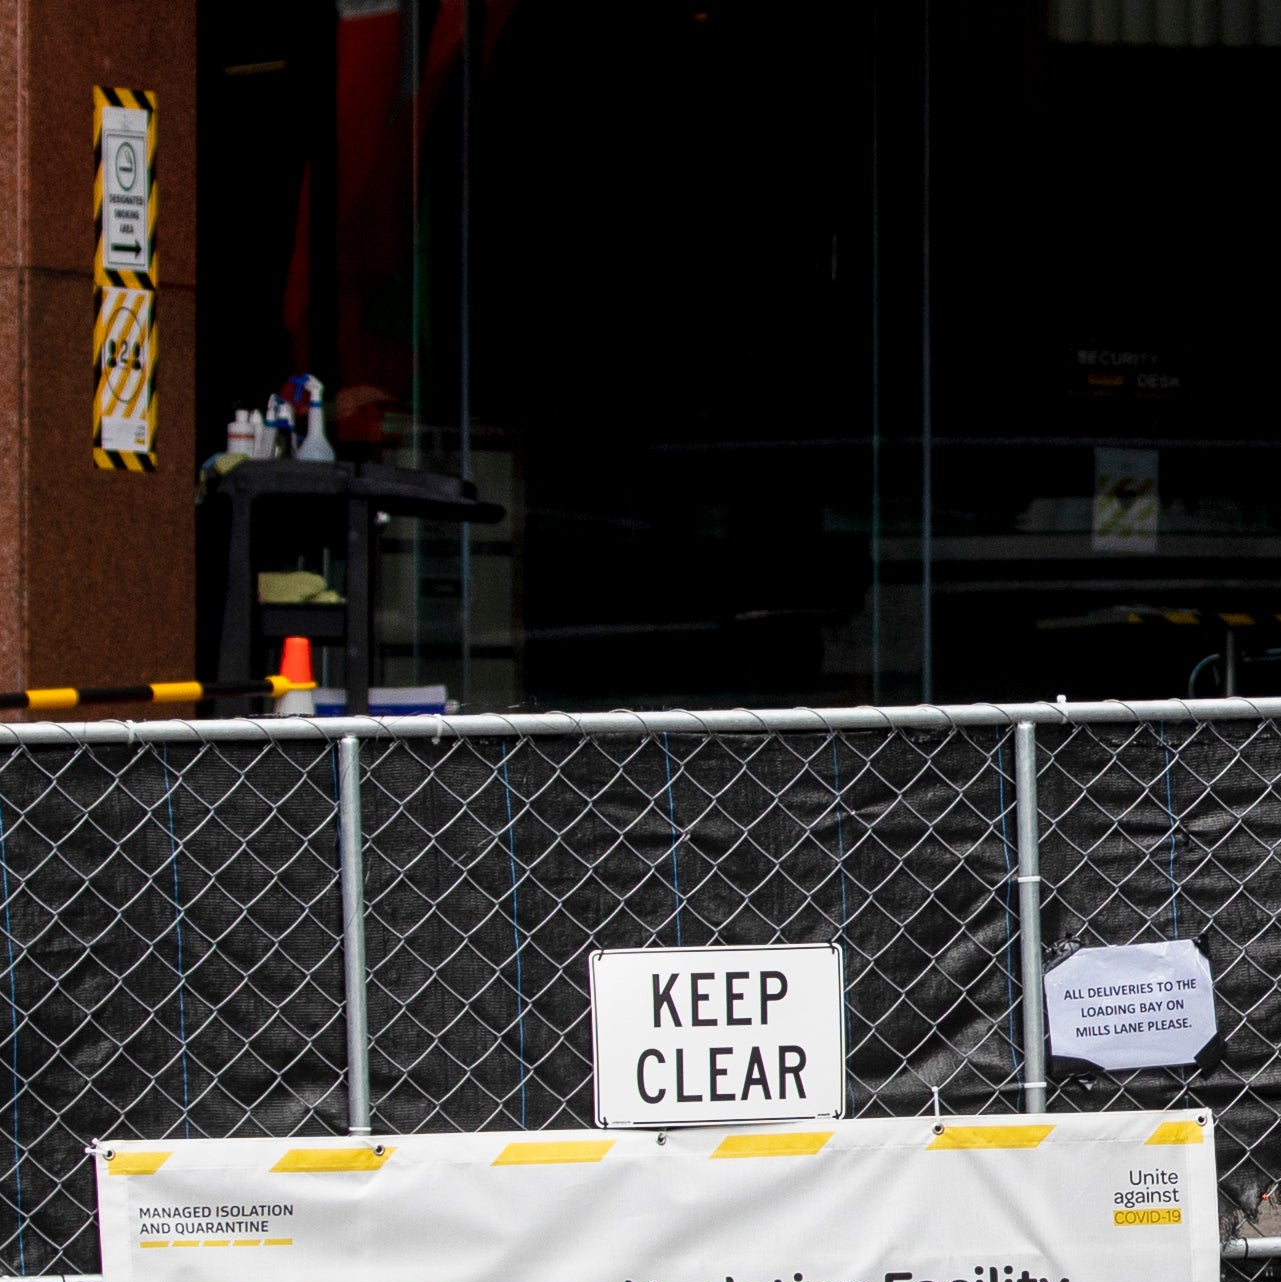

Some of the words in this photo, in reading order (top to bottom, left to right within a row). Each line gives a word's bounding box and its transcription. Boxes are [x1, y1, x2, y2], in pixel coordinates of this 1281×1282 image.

[119, 339, 128, 364] 2
[652, 971, 788, 1027] KEEP
[1064, 989, 1084, 1000] ALL
[1088, 983, 1153, 998] DELIVERIES
[1157, 981, 1173, 992] TO
[1176, 979, 1196, 990] THE
[1081, 1003, 1135, 1018] LOADING
[1140, 1001, 1163, 1013] BAY
[1166, 1000, 1184, 1010] ON
[1076, 1025, 1110, 1037] MILLS
[1114, 1022, 1144, 1034] LANE
[1148, 1018, 1192, 1031] PLEASE.
[637, 1045, 806, 1104] CLEAR
[1130, 1169, 1178, 1185] Unite
[1114, 1187, 1179, 1208] against
[140, 1207, 211, 1218] MANAGED
[216, 1205, 293, 1217] ISOLATION
[1114, 1210, 1181, 1224] COVID-19
[140, 1223, 170, 1234] AND
[176, 1221, 268, 1235] QUARANTINE
